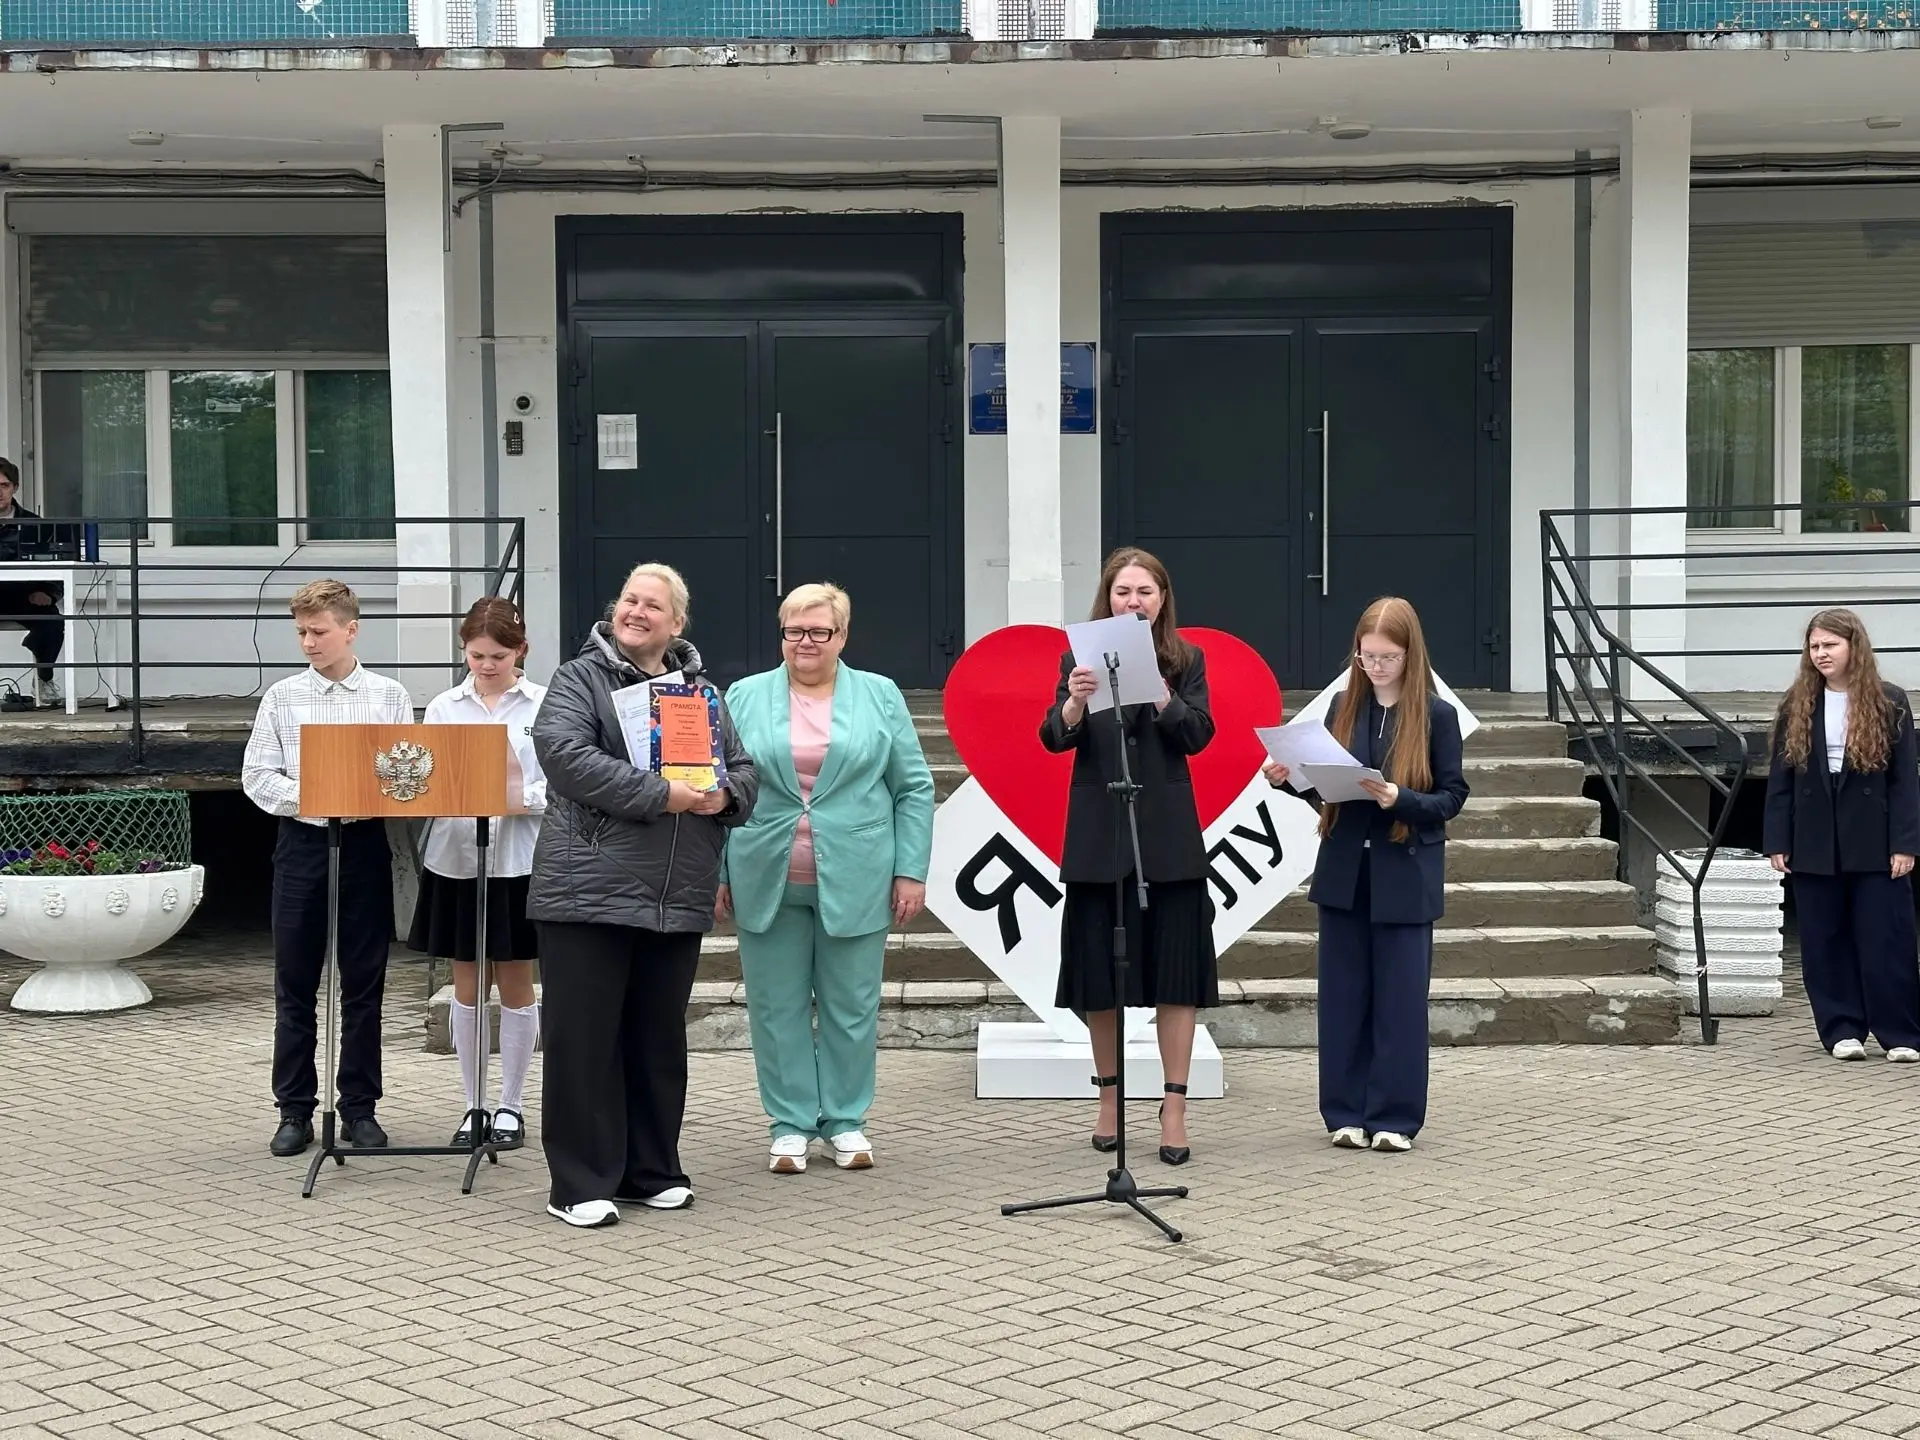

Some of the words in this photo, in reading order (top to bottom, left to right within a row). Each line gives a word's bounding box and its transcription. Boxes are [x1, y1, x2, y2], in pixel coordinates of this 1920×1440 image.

[670, 702, 702, 710] ГРАМОТА
[954, 831, 1064, 955] Я
[1206, 799, 1284, 911] ЛУ
